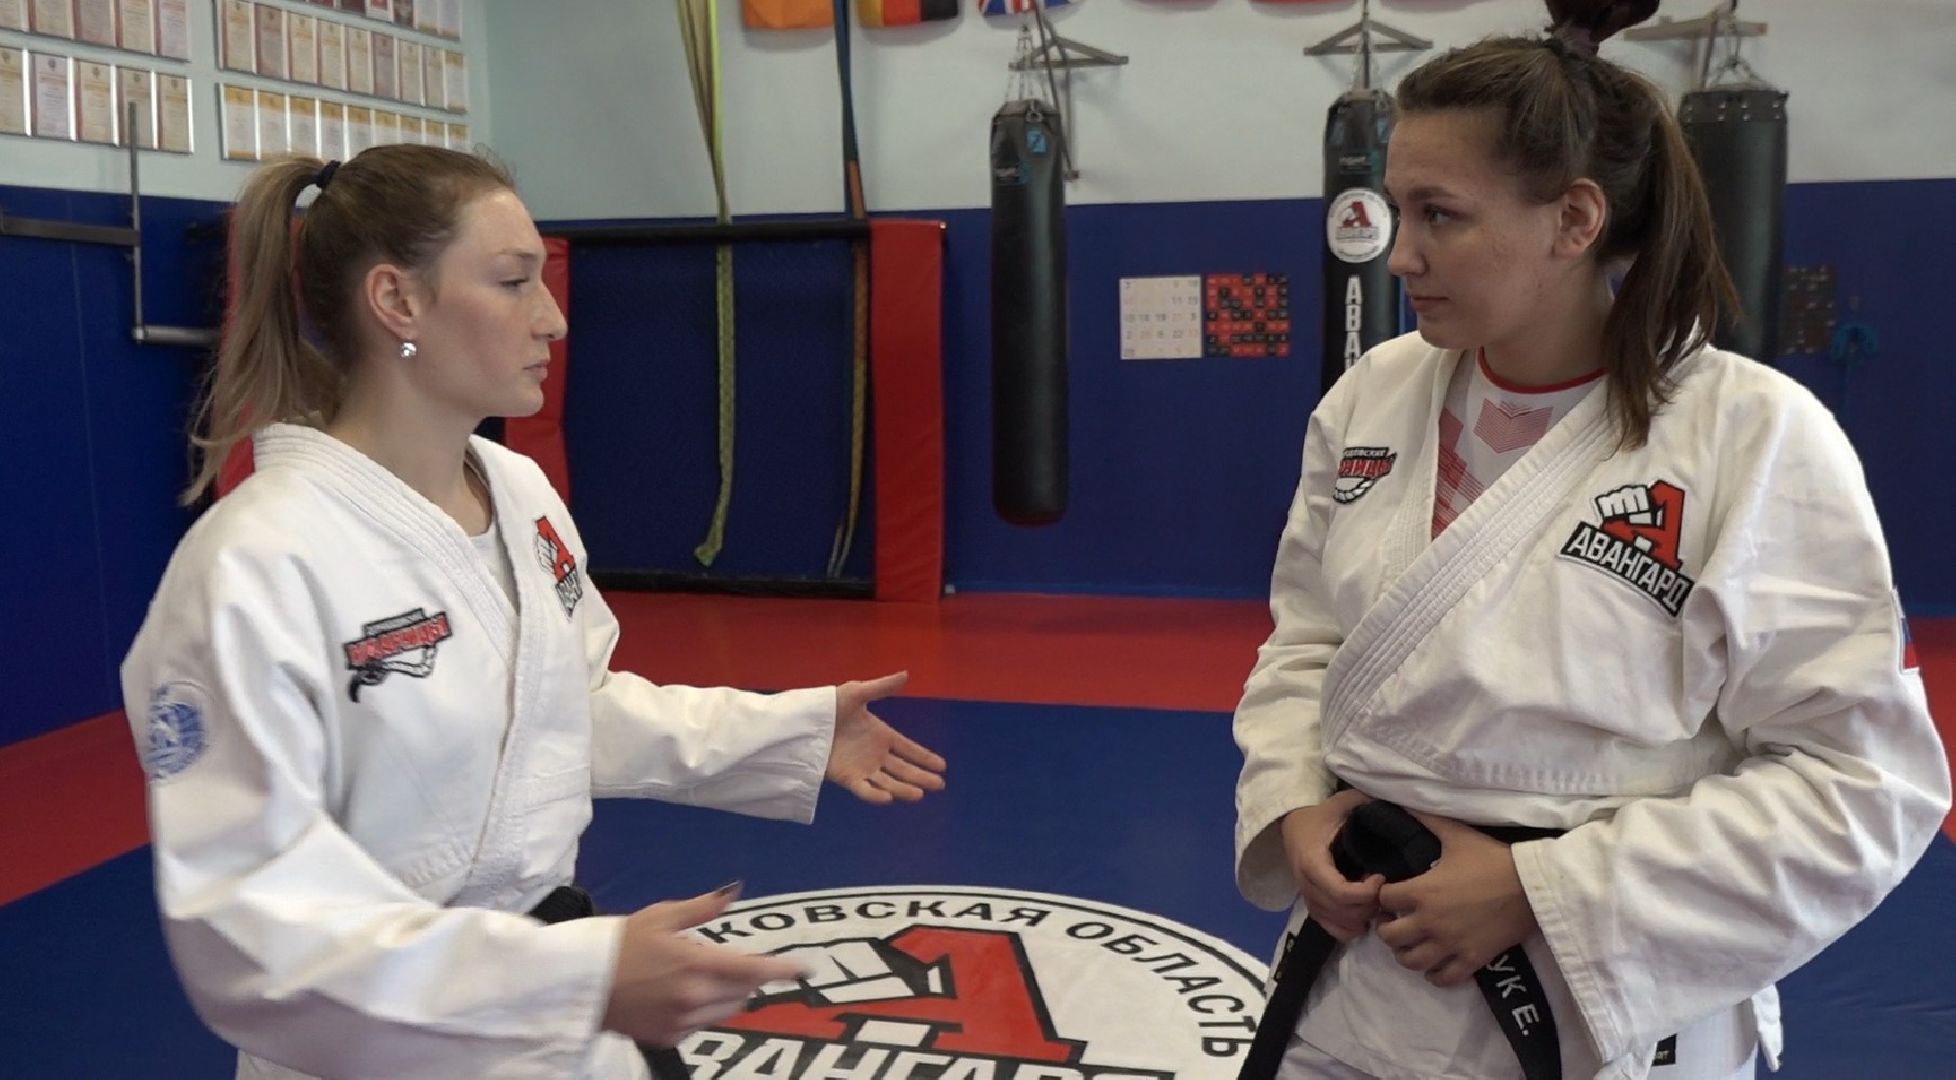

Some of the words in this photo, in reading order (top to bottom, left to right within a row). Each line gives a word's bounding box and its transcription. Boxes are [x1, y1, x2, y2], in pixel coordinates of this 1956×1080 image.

[1566, 526, 1692, 613] АВАНГАРД
[697, 900, 1052, 944] КОВСКАЯ
[1065, 921, 1258, 1059] ОБЛАСТЬ
[1485, 953, 1528, 999] УК
